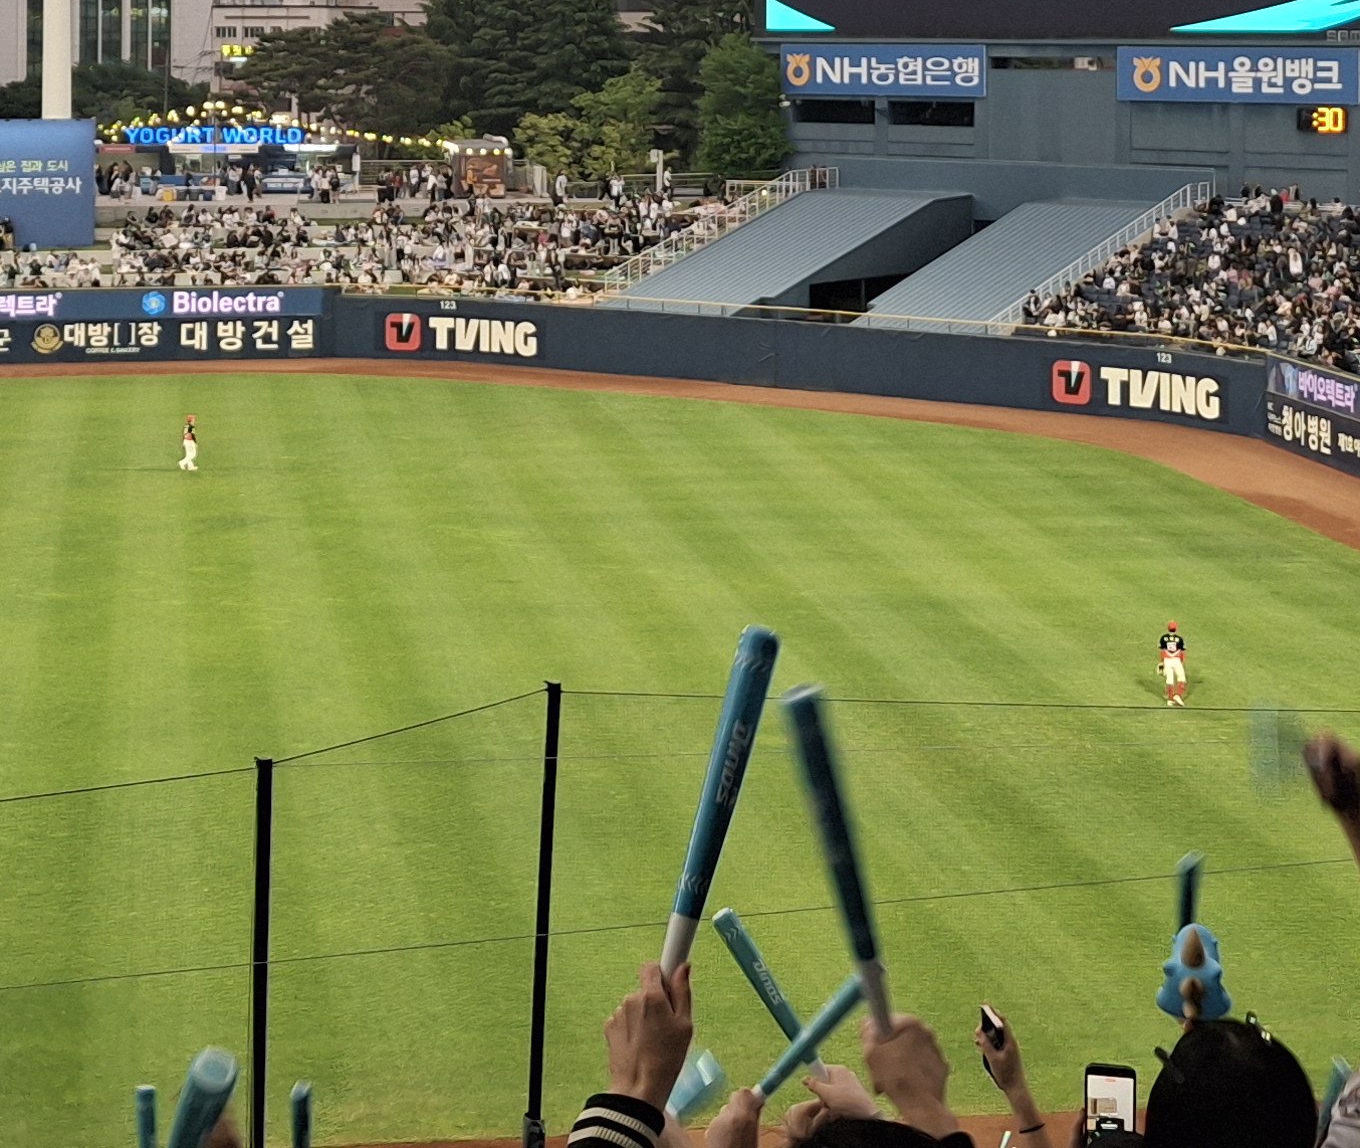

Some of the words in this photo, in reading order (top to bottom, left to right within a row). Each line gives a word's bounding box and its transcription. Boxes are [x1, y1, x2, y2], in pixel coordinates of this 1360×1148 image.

[815, 56, 980, 87] NH농협은행
[1168, 56, 1343, 95] NH올원뱅크
[125, 127, 215, 144] YOGURT
[222, 127, 303, 144] WORLD
[20, 160, 43, 173] 집과
[46, 160, 69, 172] 도시
[173, 290, 281, 314] Biolectra
[440, 301, 456, 310] 123
[180, 319, 315, 350] 대방건설
[429, 316, 538, 358] TVING
[1156, 352, 1173, 364] 123
[1100, 366, 1221, 420] TVING
[1298, 371, 1356, 413] 바이오렉트라
